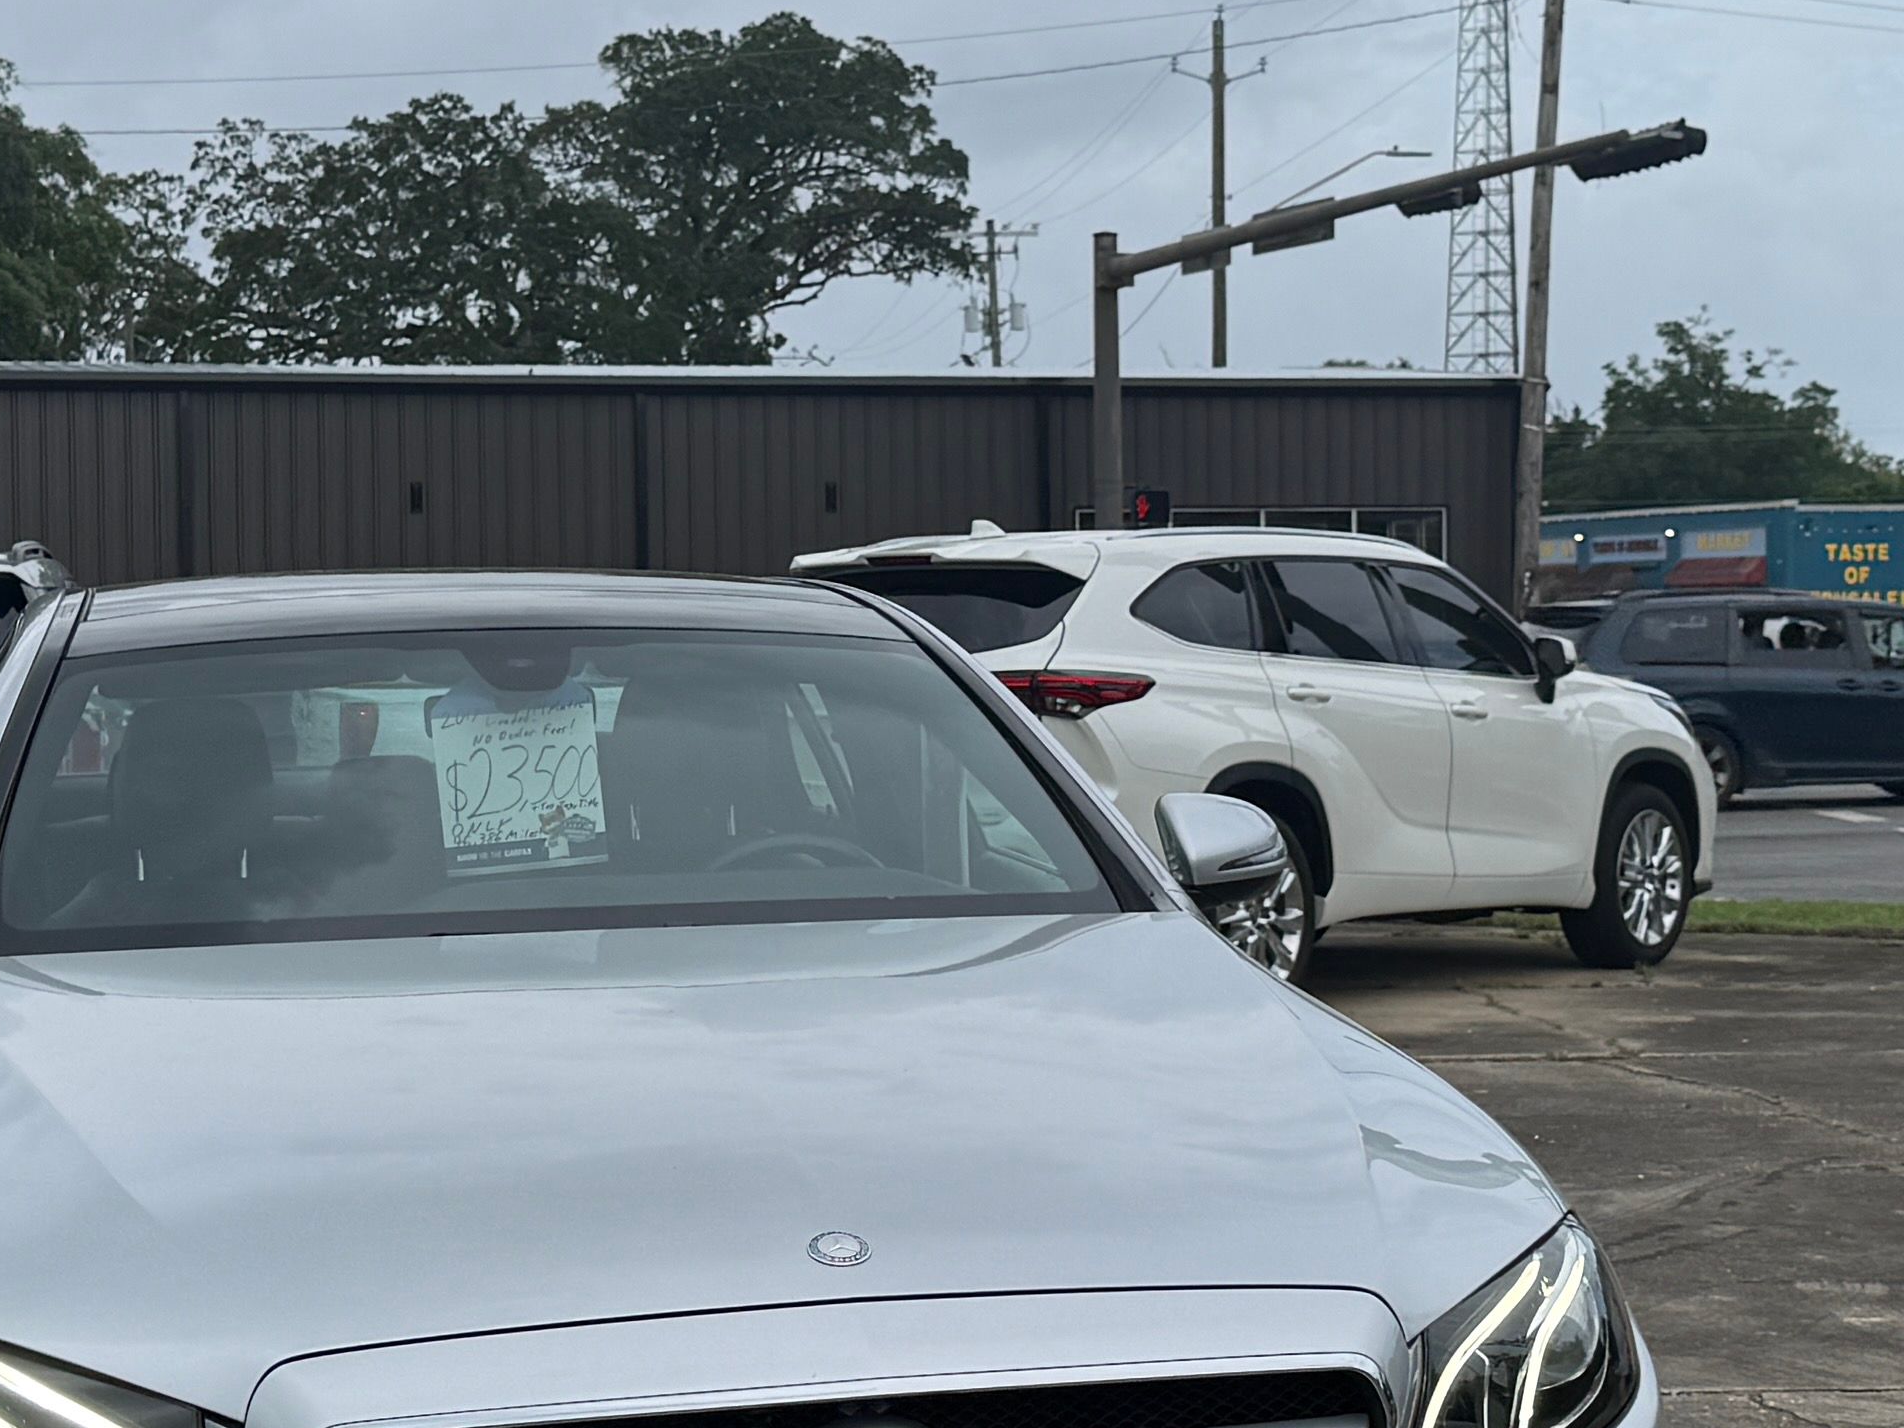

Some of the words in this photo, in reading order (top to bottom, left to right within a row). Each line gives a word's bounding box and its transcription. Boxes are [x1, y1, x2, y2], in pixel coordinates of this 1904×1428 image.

[1825, 543, 1890, 562] TASTE
[1844, 566, 1871, 586] OF
[473, 733, 492, 747] NO
